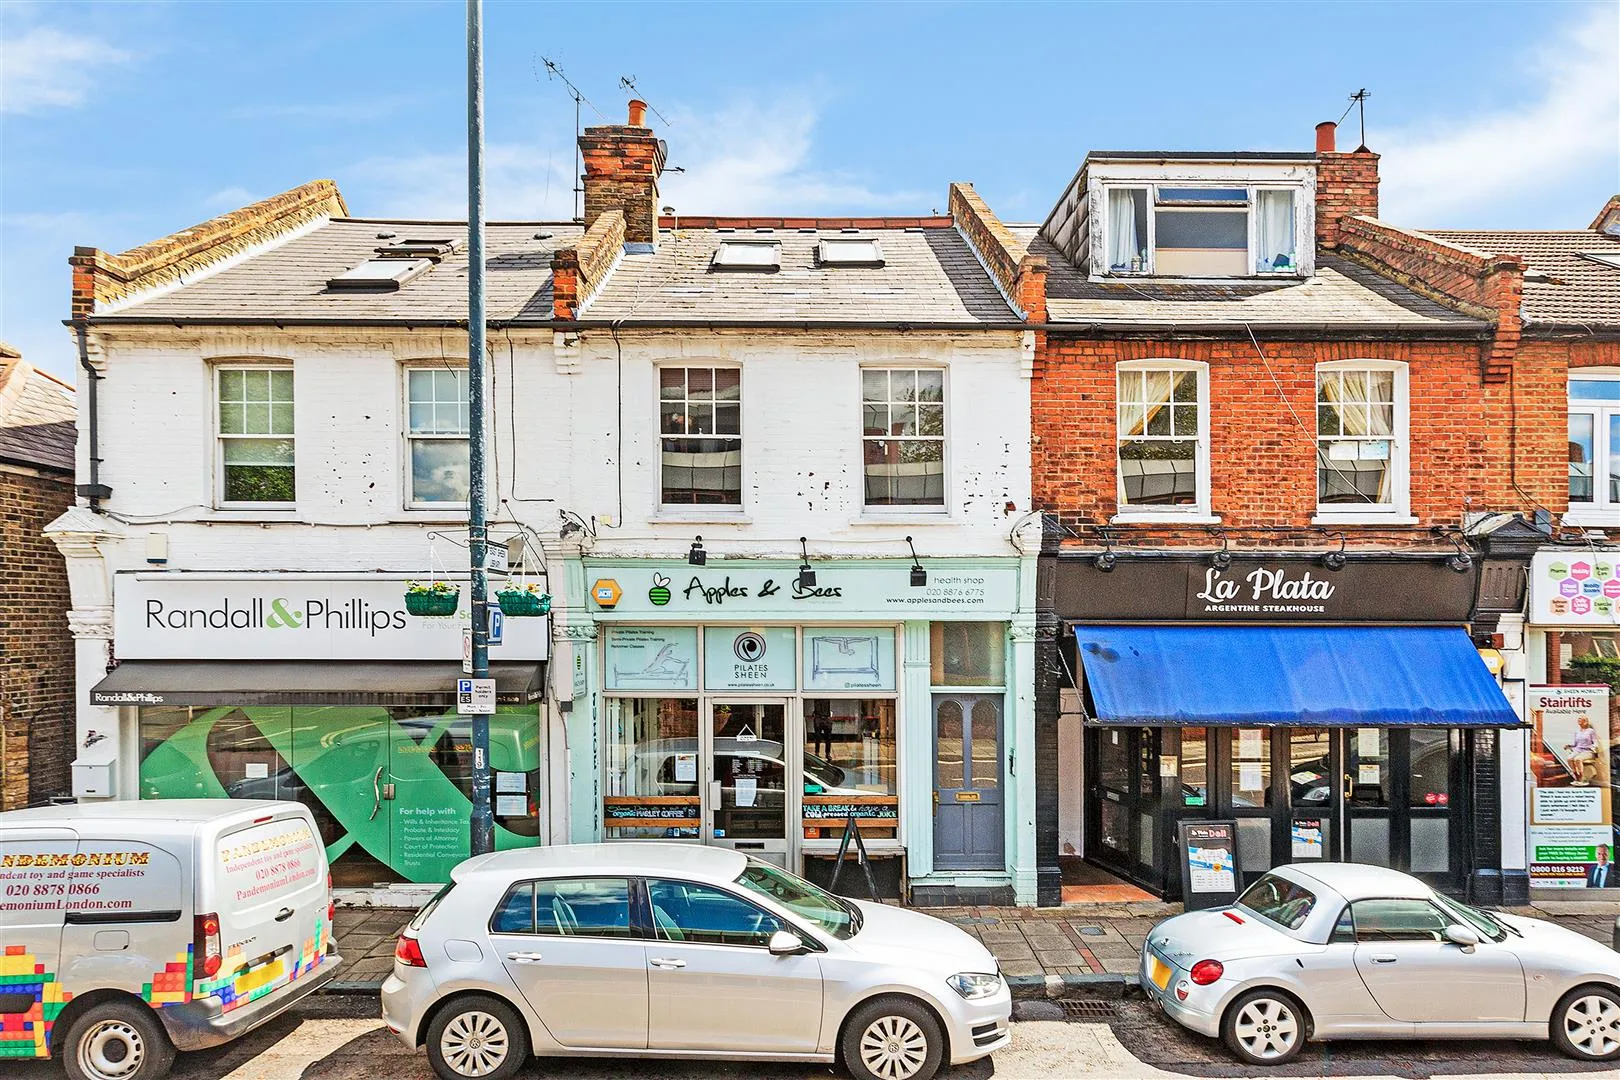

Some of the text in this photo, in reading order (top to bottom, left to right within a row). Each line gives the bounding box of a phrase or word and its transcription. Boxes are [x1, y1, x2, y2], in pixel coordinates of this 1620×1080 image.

[964, 577, 984, 585] shop
[1196, 567, 1335, 603] La Plata
[683, 576, 842, 604] Apples & Bees
[926, 588, 985, 596] 020 8876 6775
[146, 597, 406, 637] Randall&Phillips
[734, 671, 767, 679] SHEEN
[462, 681, 471, 690] P
[95, 692, 164, 704] Randall&Phillips
[1540, 697, 1592, 708] Stairlifts
[399, 807, 456, 816] For help with
[225, 856, 264, 874] Independent
[29, 872, 43, 881] toy
[47, 870, 65, 879] and
[68, 870, 94, 880] game
[96, 868, 145, 878] specialists
[255, 868, 270, 881] 020
[6, 883, 100, 896] 020 8878 0866
